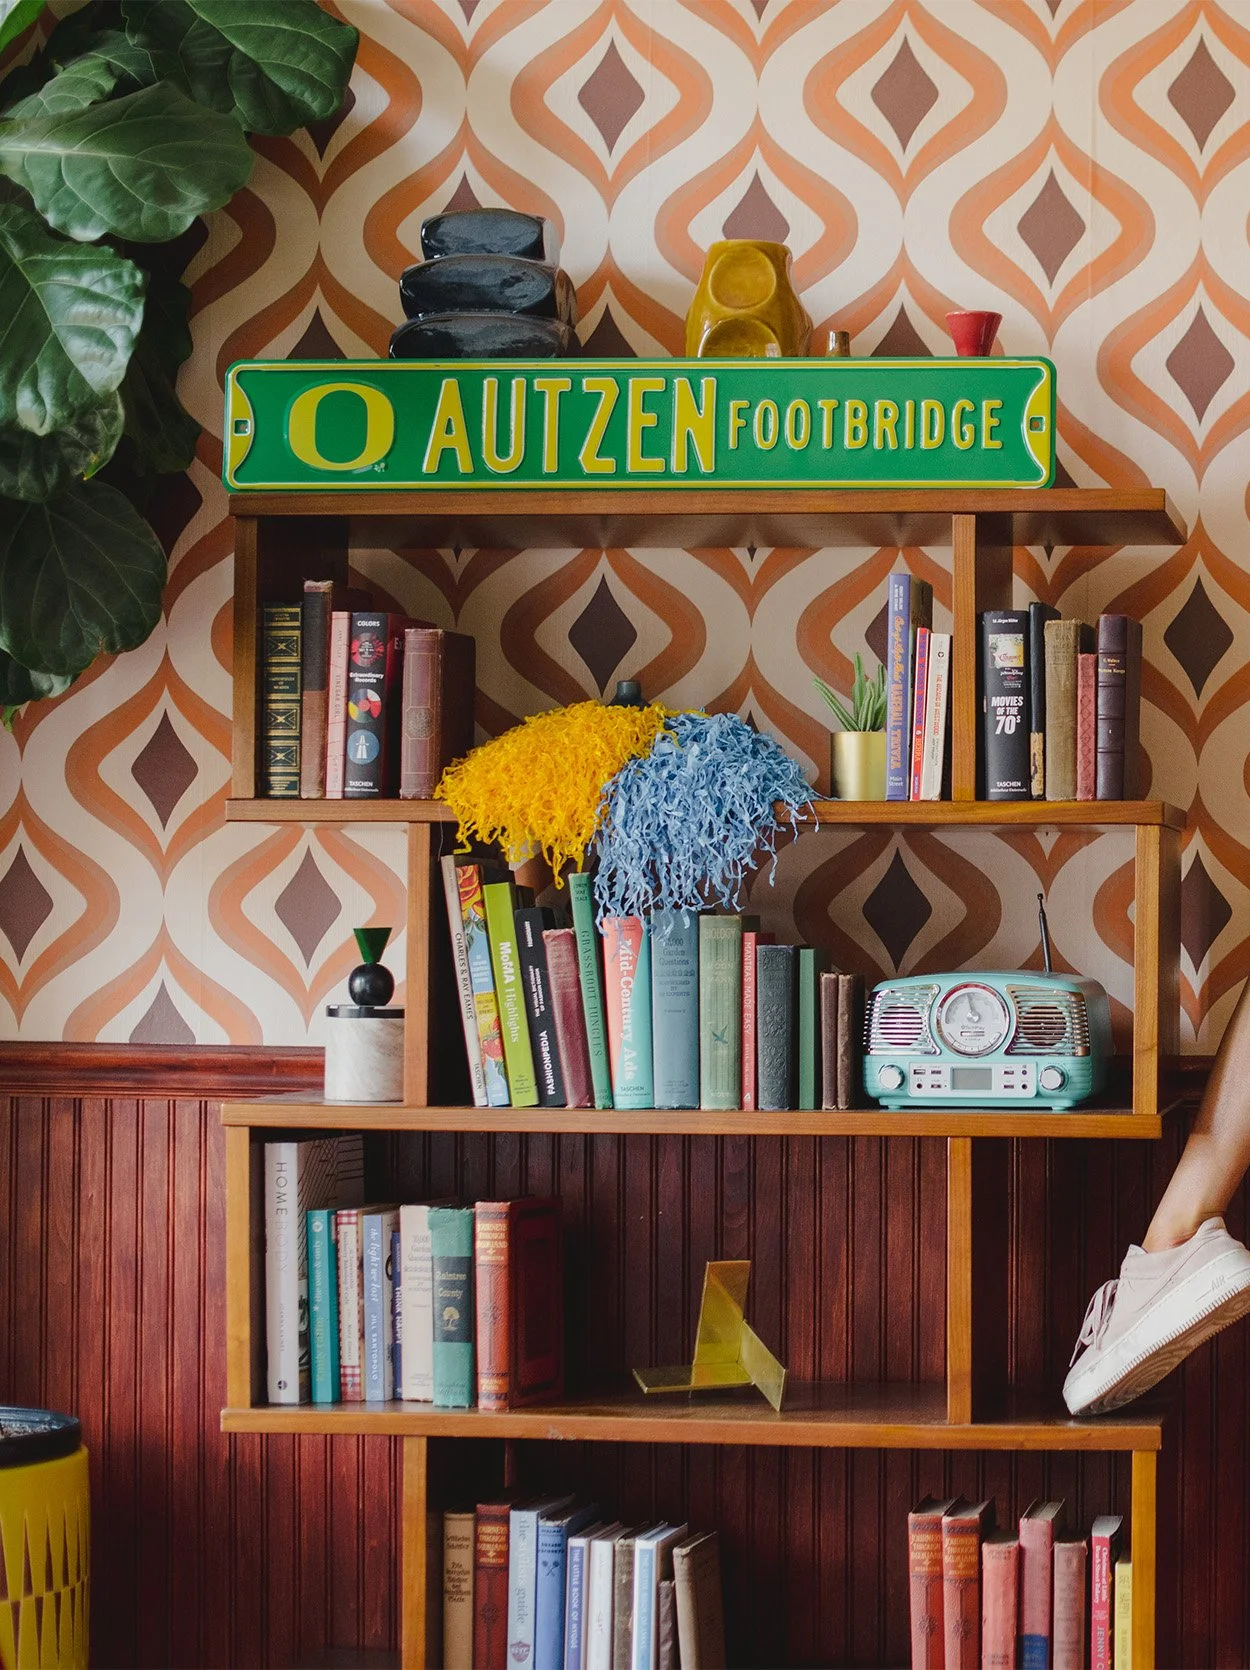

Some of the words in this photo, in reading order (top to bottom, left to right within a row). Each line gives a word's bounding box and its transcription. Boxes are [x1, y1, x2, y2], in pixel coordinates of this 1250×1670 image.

[422, 377, 717, 474] AUTZEN
[729, 400, 1003, 450] FOOTBRIDGE
[991, 696, 1023, 707] MOVIES
[997, 707, 1005, 715] OF
[1006, 707, 1018, 715] THE
[890, 728, 902, 769] TRIVIA
[704, 928, 736, 939] BIOLOGY
[455, 932, 466, 967] CHARLES
[500, 941, 512, 984] MoMA
[582, 930, 597, 1001] GRASSROOT
[744, 942, 752, 982] MANTRAS
[462, 977, 470, 994] RAY
[619, 939, 635, 1044] Mid-Century
[744, 986, 752, 1008] MADE
[464, 995, 474, 1020] EAMES
[503, 986, 520, 1043] Highlights
[589, 1003, 602, 1057] JUNGLES
[744, 1013, 752, 1034] EASY
[539, 1030, 556, 1095] FASHIONPEDIA
[623, 1047, 637, 1080] Ads
[370, 1228, 378, 1240] the
[313, 1240, 323, 1259] only
[368, 1242, 380, 1266] light
[436, 1271, 467, 1280] Raintree
[371, 1283, 380, 1301] lost
[439, 1288, 463, 1300] County
[519, 1519, 530, 1540] the
[515, 1587, 529, 1623] guide
[571, 1611, 578, 1621] OF
[570, 1623, 578, 1648] HYGGE
[1096, 1625, 1104, 1659] JENNY
[512, 1646, 530, 1656] NYC
